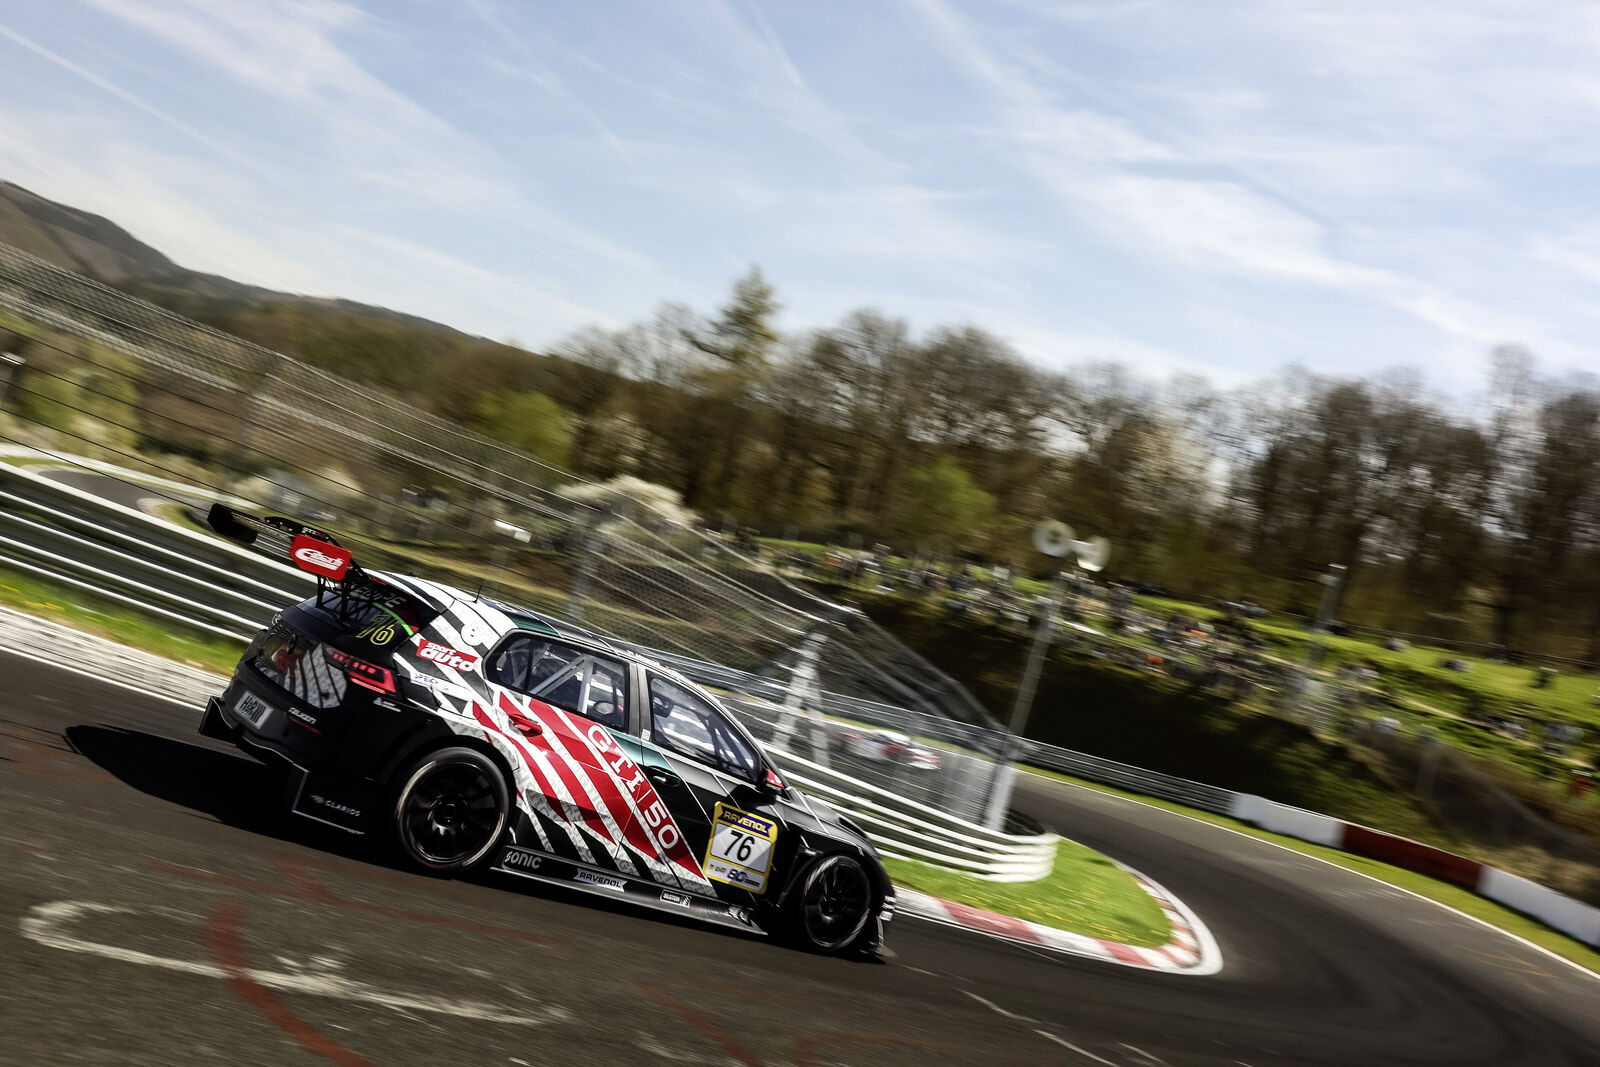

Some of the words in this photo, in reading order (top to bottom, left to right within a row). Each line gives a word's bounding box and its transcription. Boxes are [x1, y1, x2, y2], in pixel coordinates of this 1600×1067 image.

[355, 615, 396, 645] 76
[420, 648, 475, 672] auto
[425, 642, 457, 656] sport
[587, 725, 645, 793] GTI
[643, 800, 679, 849] 50
[723, 810, 768, 833] RAVENOL
[723, 829, 755, 862] 76
[579, 871, 622, 888] RAVENOL
